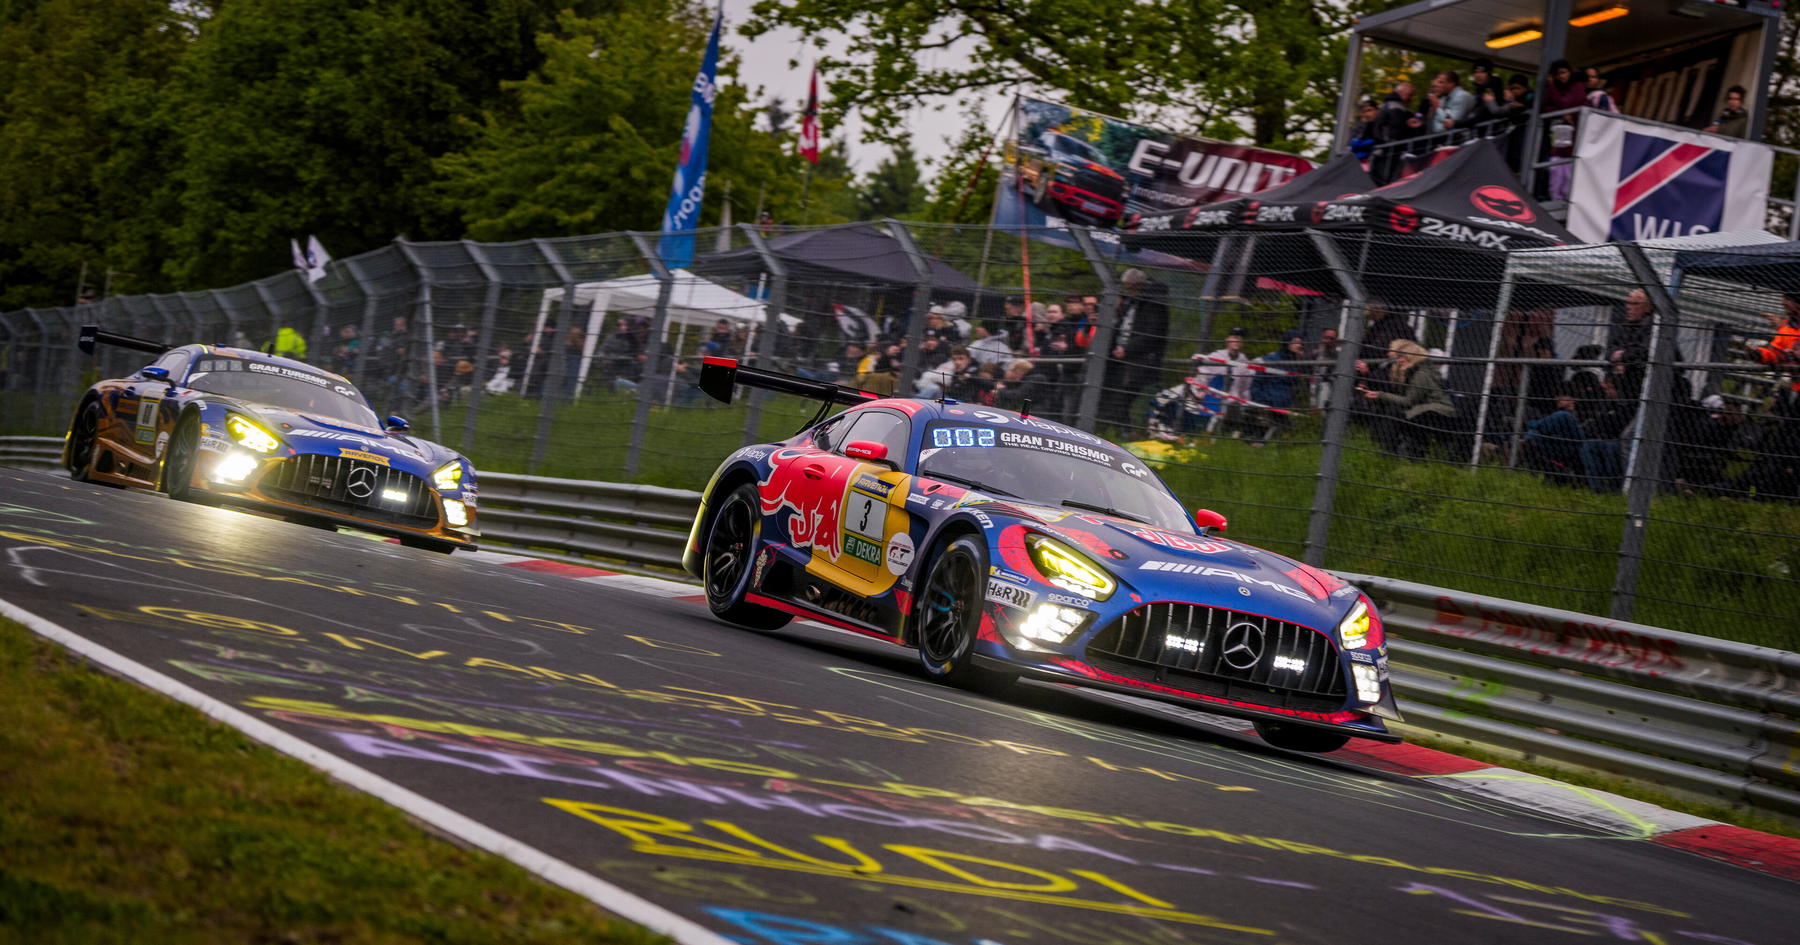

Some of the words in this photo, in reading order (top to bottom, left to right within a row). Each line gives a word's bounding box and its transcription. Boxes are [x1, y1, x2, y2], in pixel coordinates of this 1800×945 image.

[1128, 139, 1296, 194] E-UNIT
[1257, 206, 1298, 222] 24MX
[1323, 204, 1367, 222] 24MX
[1419, 217, 1511, 250] 24MX
[249, 363, 279, 373] GRAN
[281, 368, 328, 385] TURISMO
[1008, 416, 1104, 446] viaplay
[344, 450, 388, 464] RAVENOL
[1000, 432, 1042, 447] GRAN
[1046, 438, 1112, 463] TURISMO
[857, 477, 889, 495] RAVENOL
[859, 499, 873, 532] 3
[856, 541, 882, 566] DEKRA
[988, 581, 1012, 600] H&R
[1199, 566, 1317, 604] AMG
[1047, 592, 1090, 608] sparco
[542, 797, 1176, 910] RUDI
